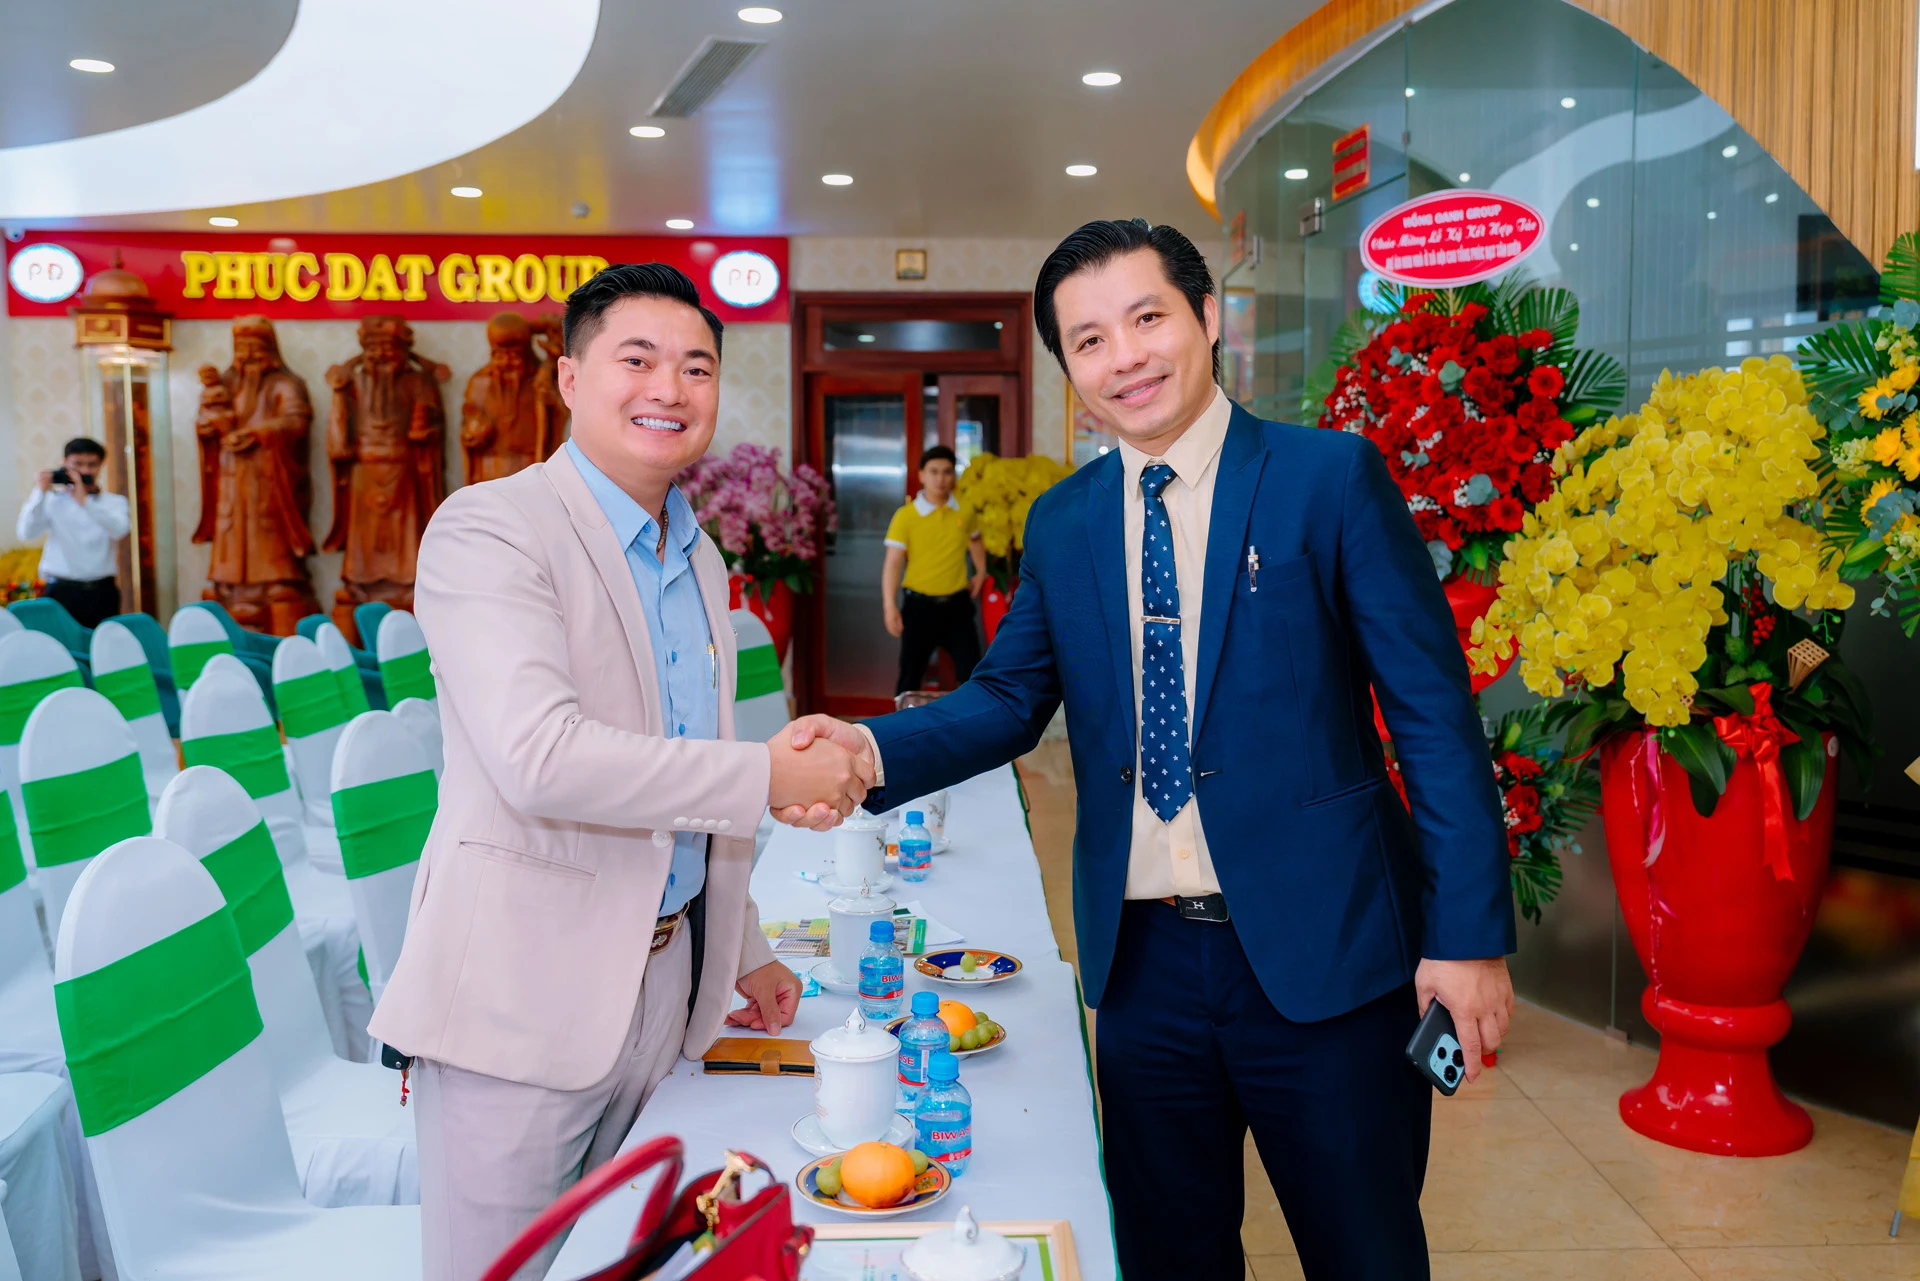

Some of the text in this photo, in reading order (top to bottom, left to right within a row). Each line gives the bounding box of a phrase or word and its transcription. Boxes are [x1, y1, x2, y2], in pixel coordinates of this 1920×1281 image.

[1466, 204, 1502, 220] GROUP
[181, 251, 321, 301] PHUC
[324, 253, 435, 301] DAT
